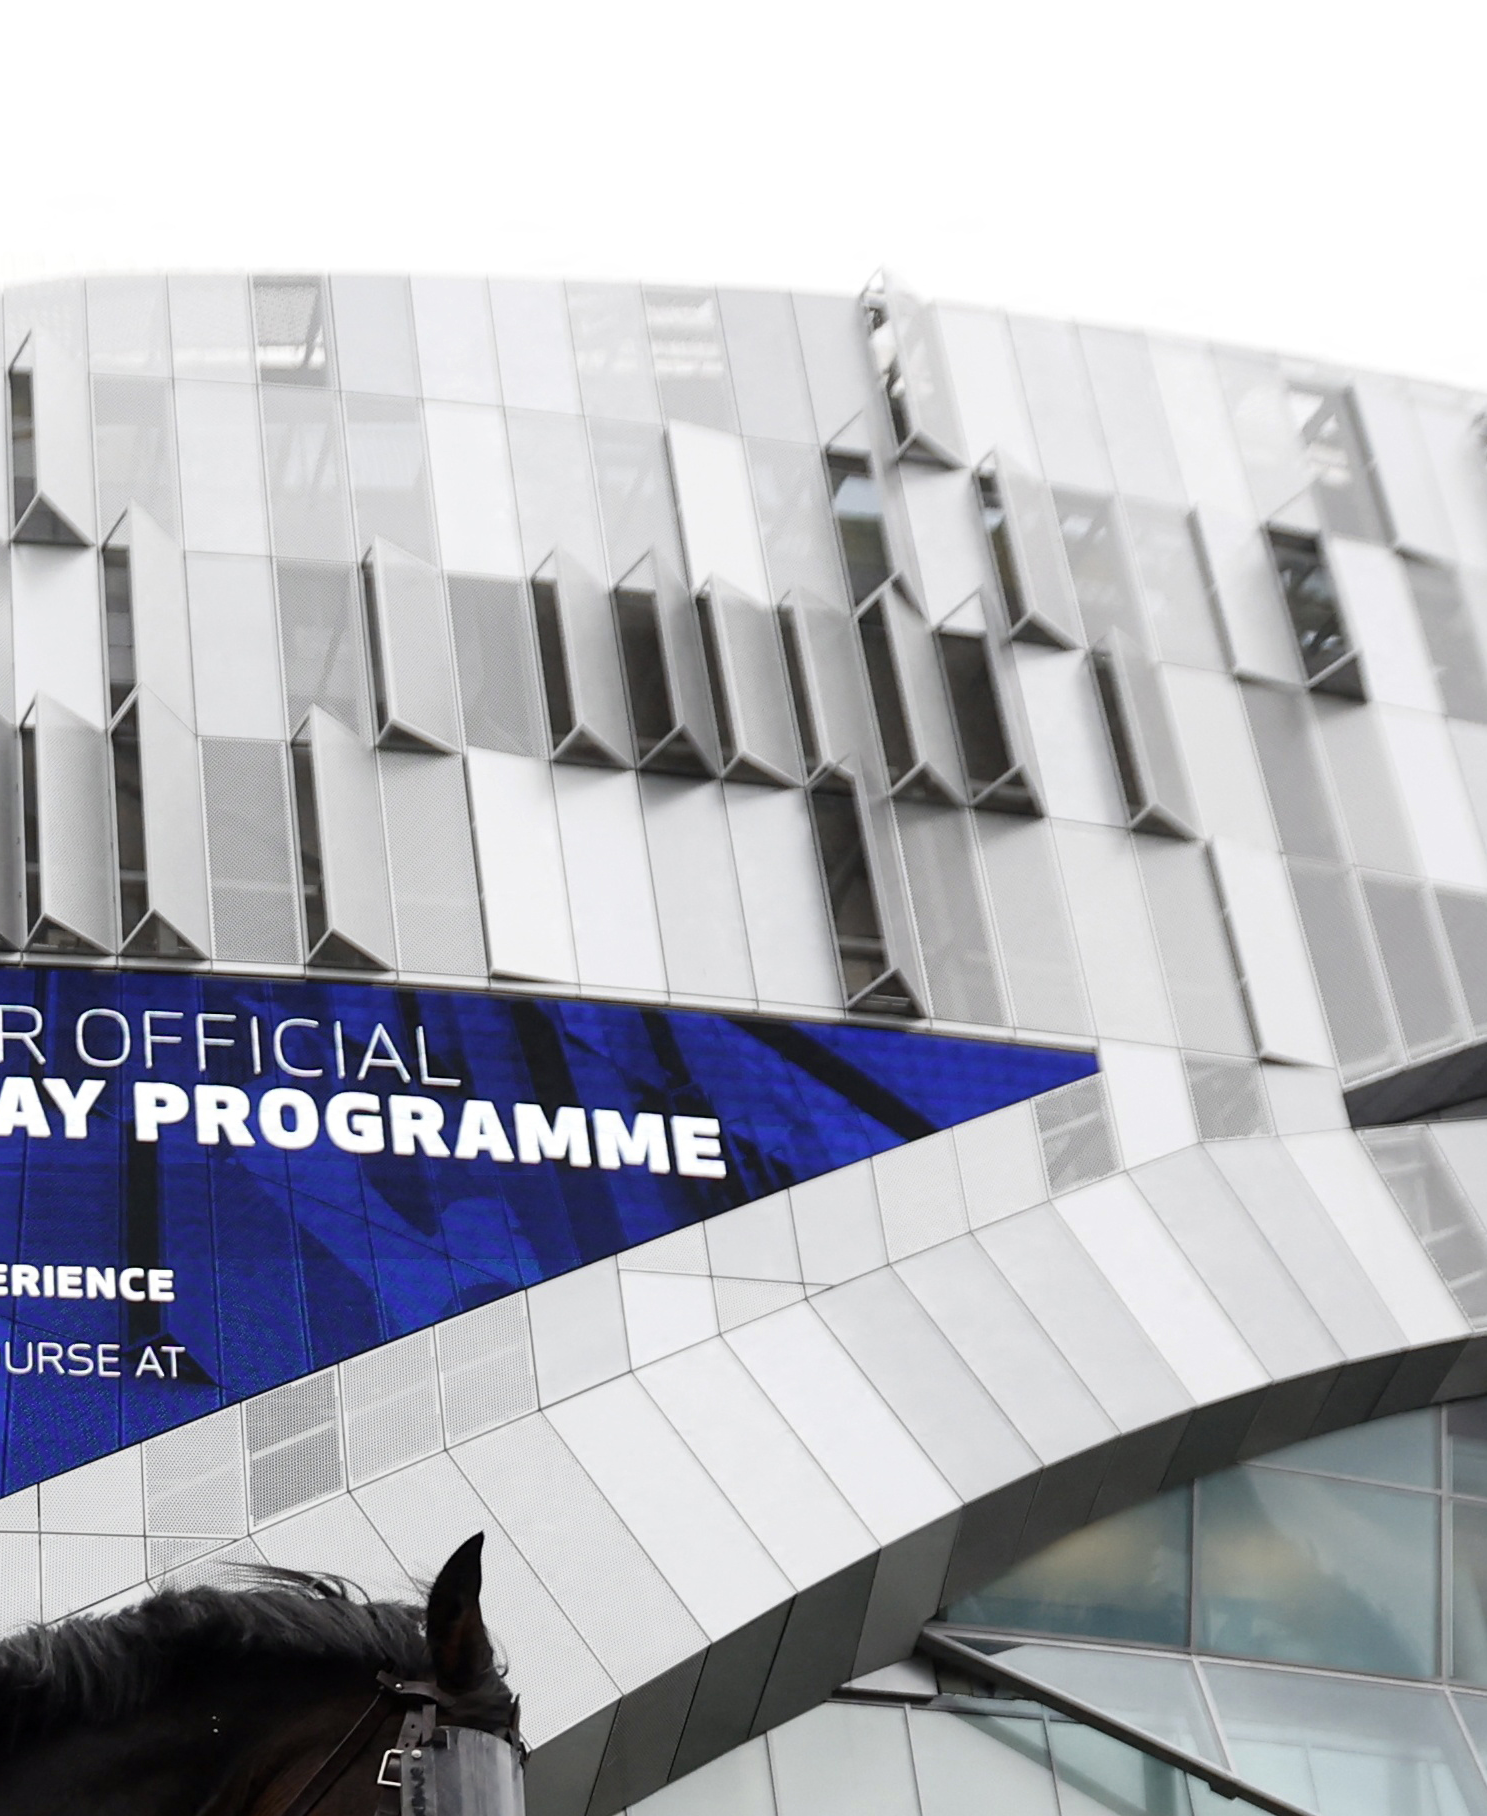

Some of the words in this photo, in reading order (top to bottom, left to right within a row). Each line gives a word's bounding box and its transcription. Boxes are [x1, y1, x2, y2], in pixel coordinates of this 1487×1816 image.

[76, 1008, 461, 1087] OFFICIAL
[133, 1081, 727, 1179] PROGRAMME
[135, 1345, 186, 1379] AT
